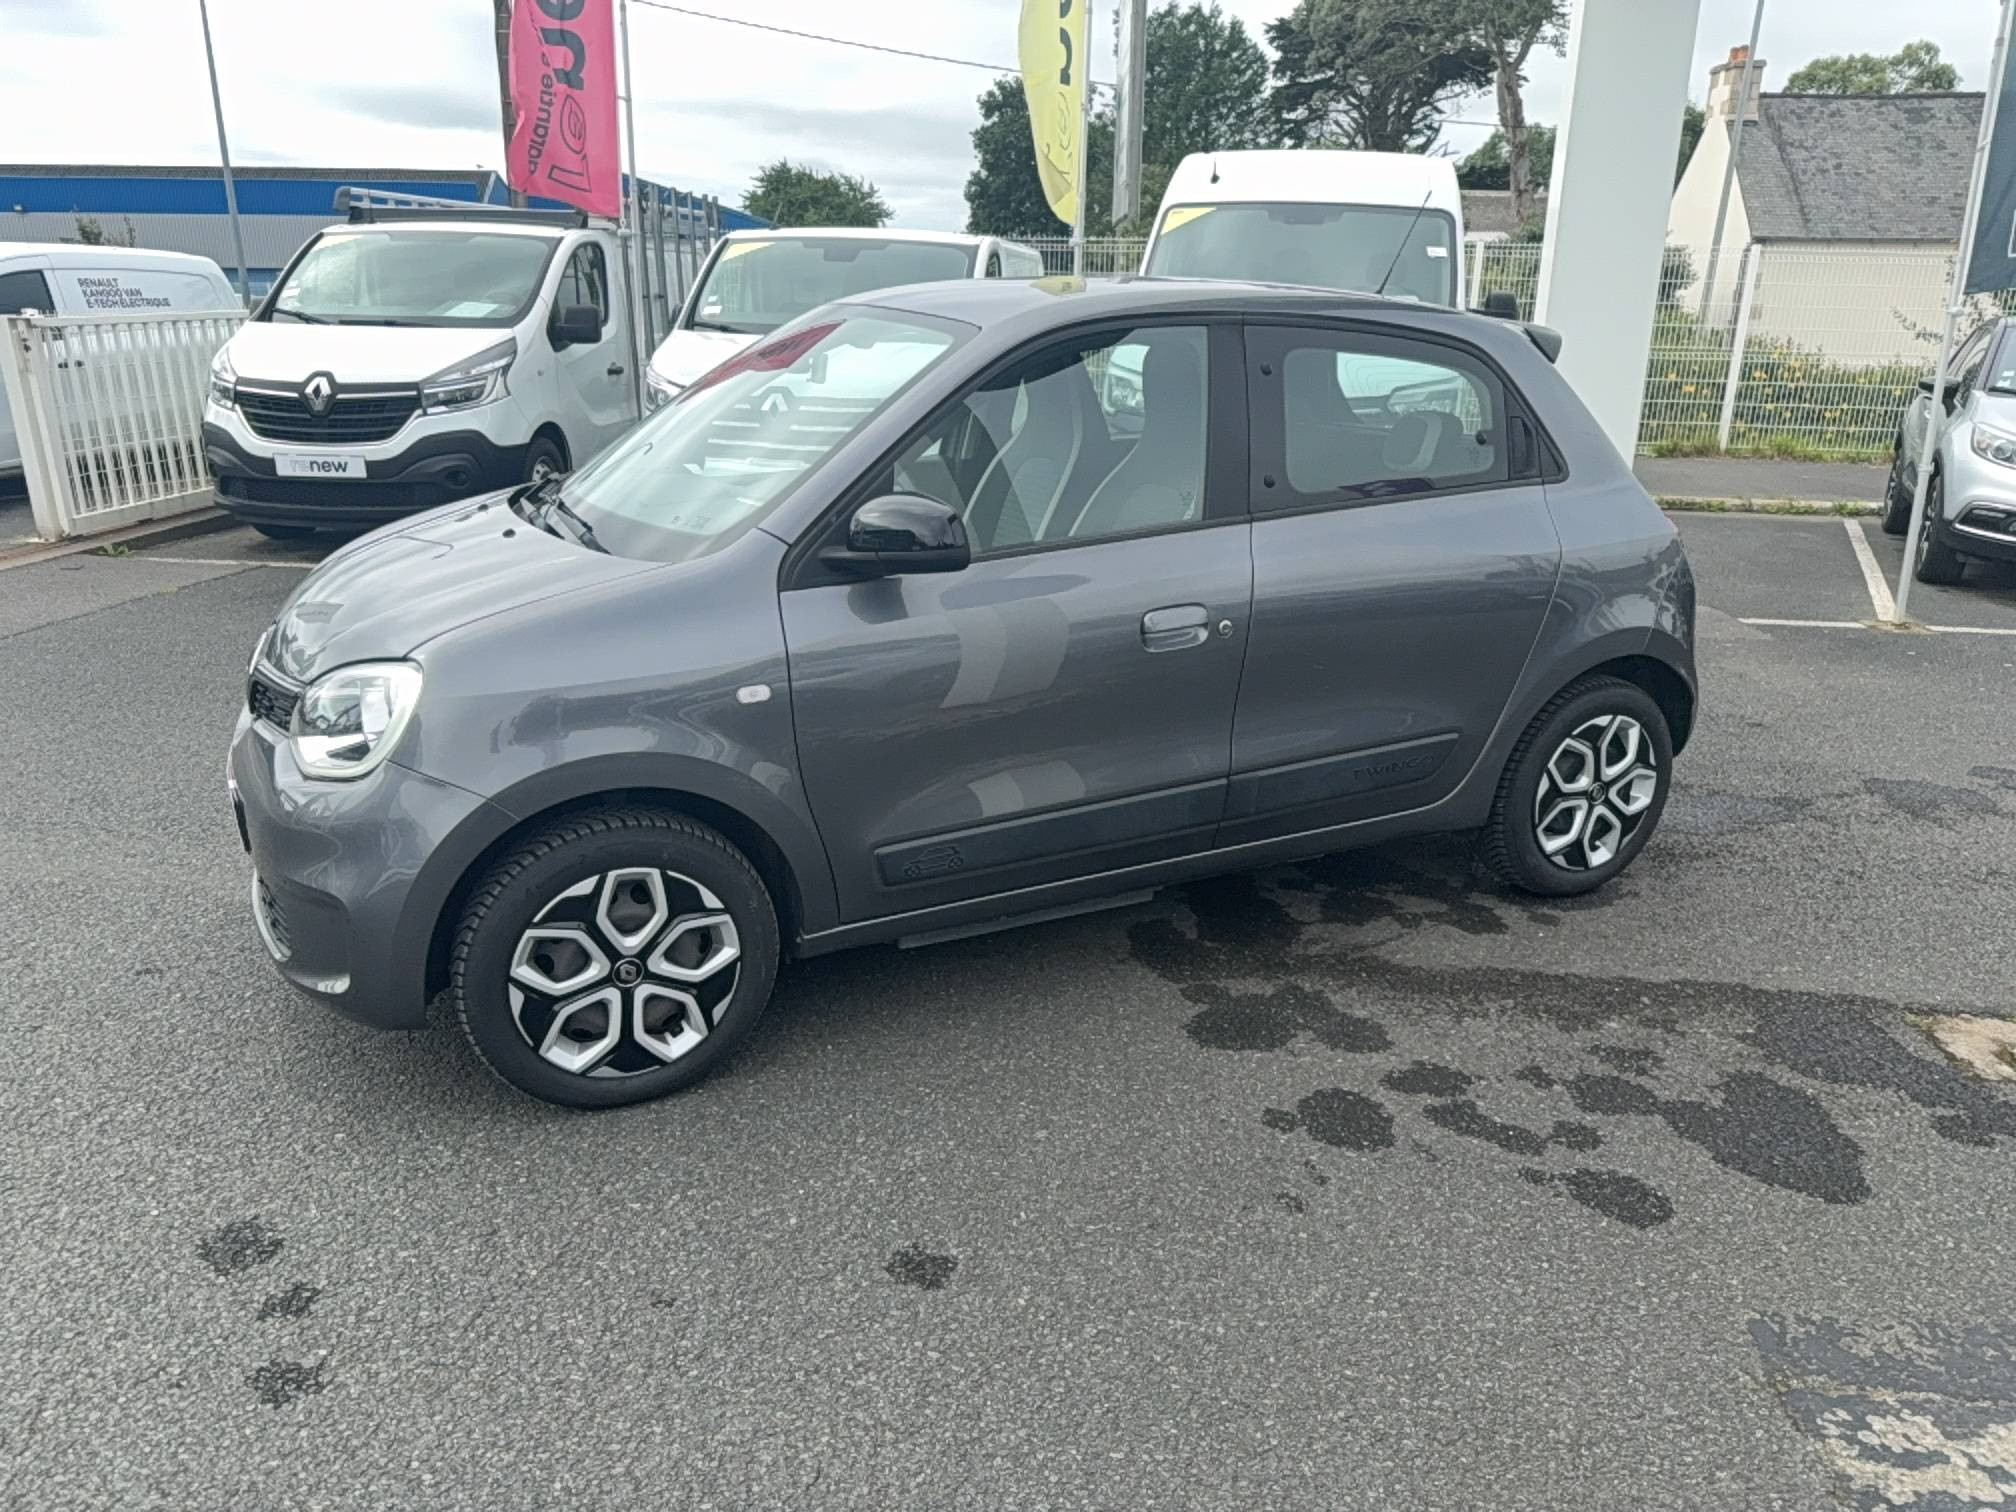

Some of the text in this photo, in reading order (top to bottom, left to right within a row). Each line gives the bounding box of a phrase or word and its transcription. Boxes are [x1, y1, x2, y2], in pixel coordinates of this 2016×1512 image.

[77, 278, 118, 287] RENAULT
[81, 288, 142, 297] KANGOO VAN
[86, 298, 119, 308] E-TECH
